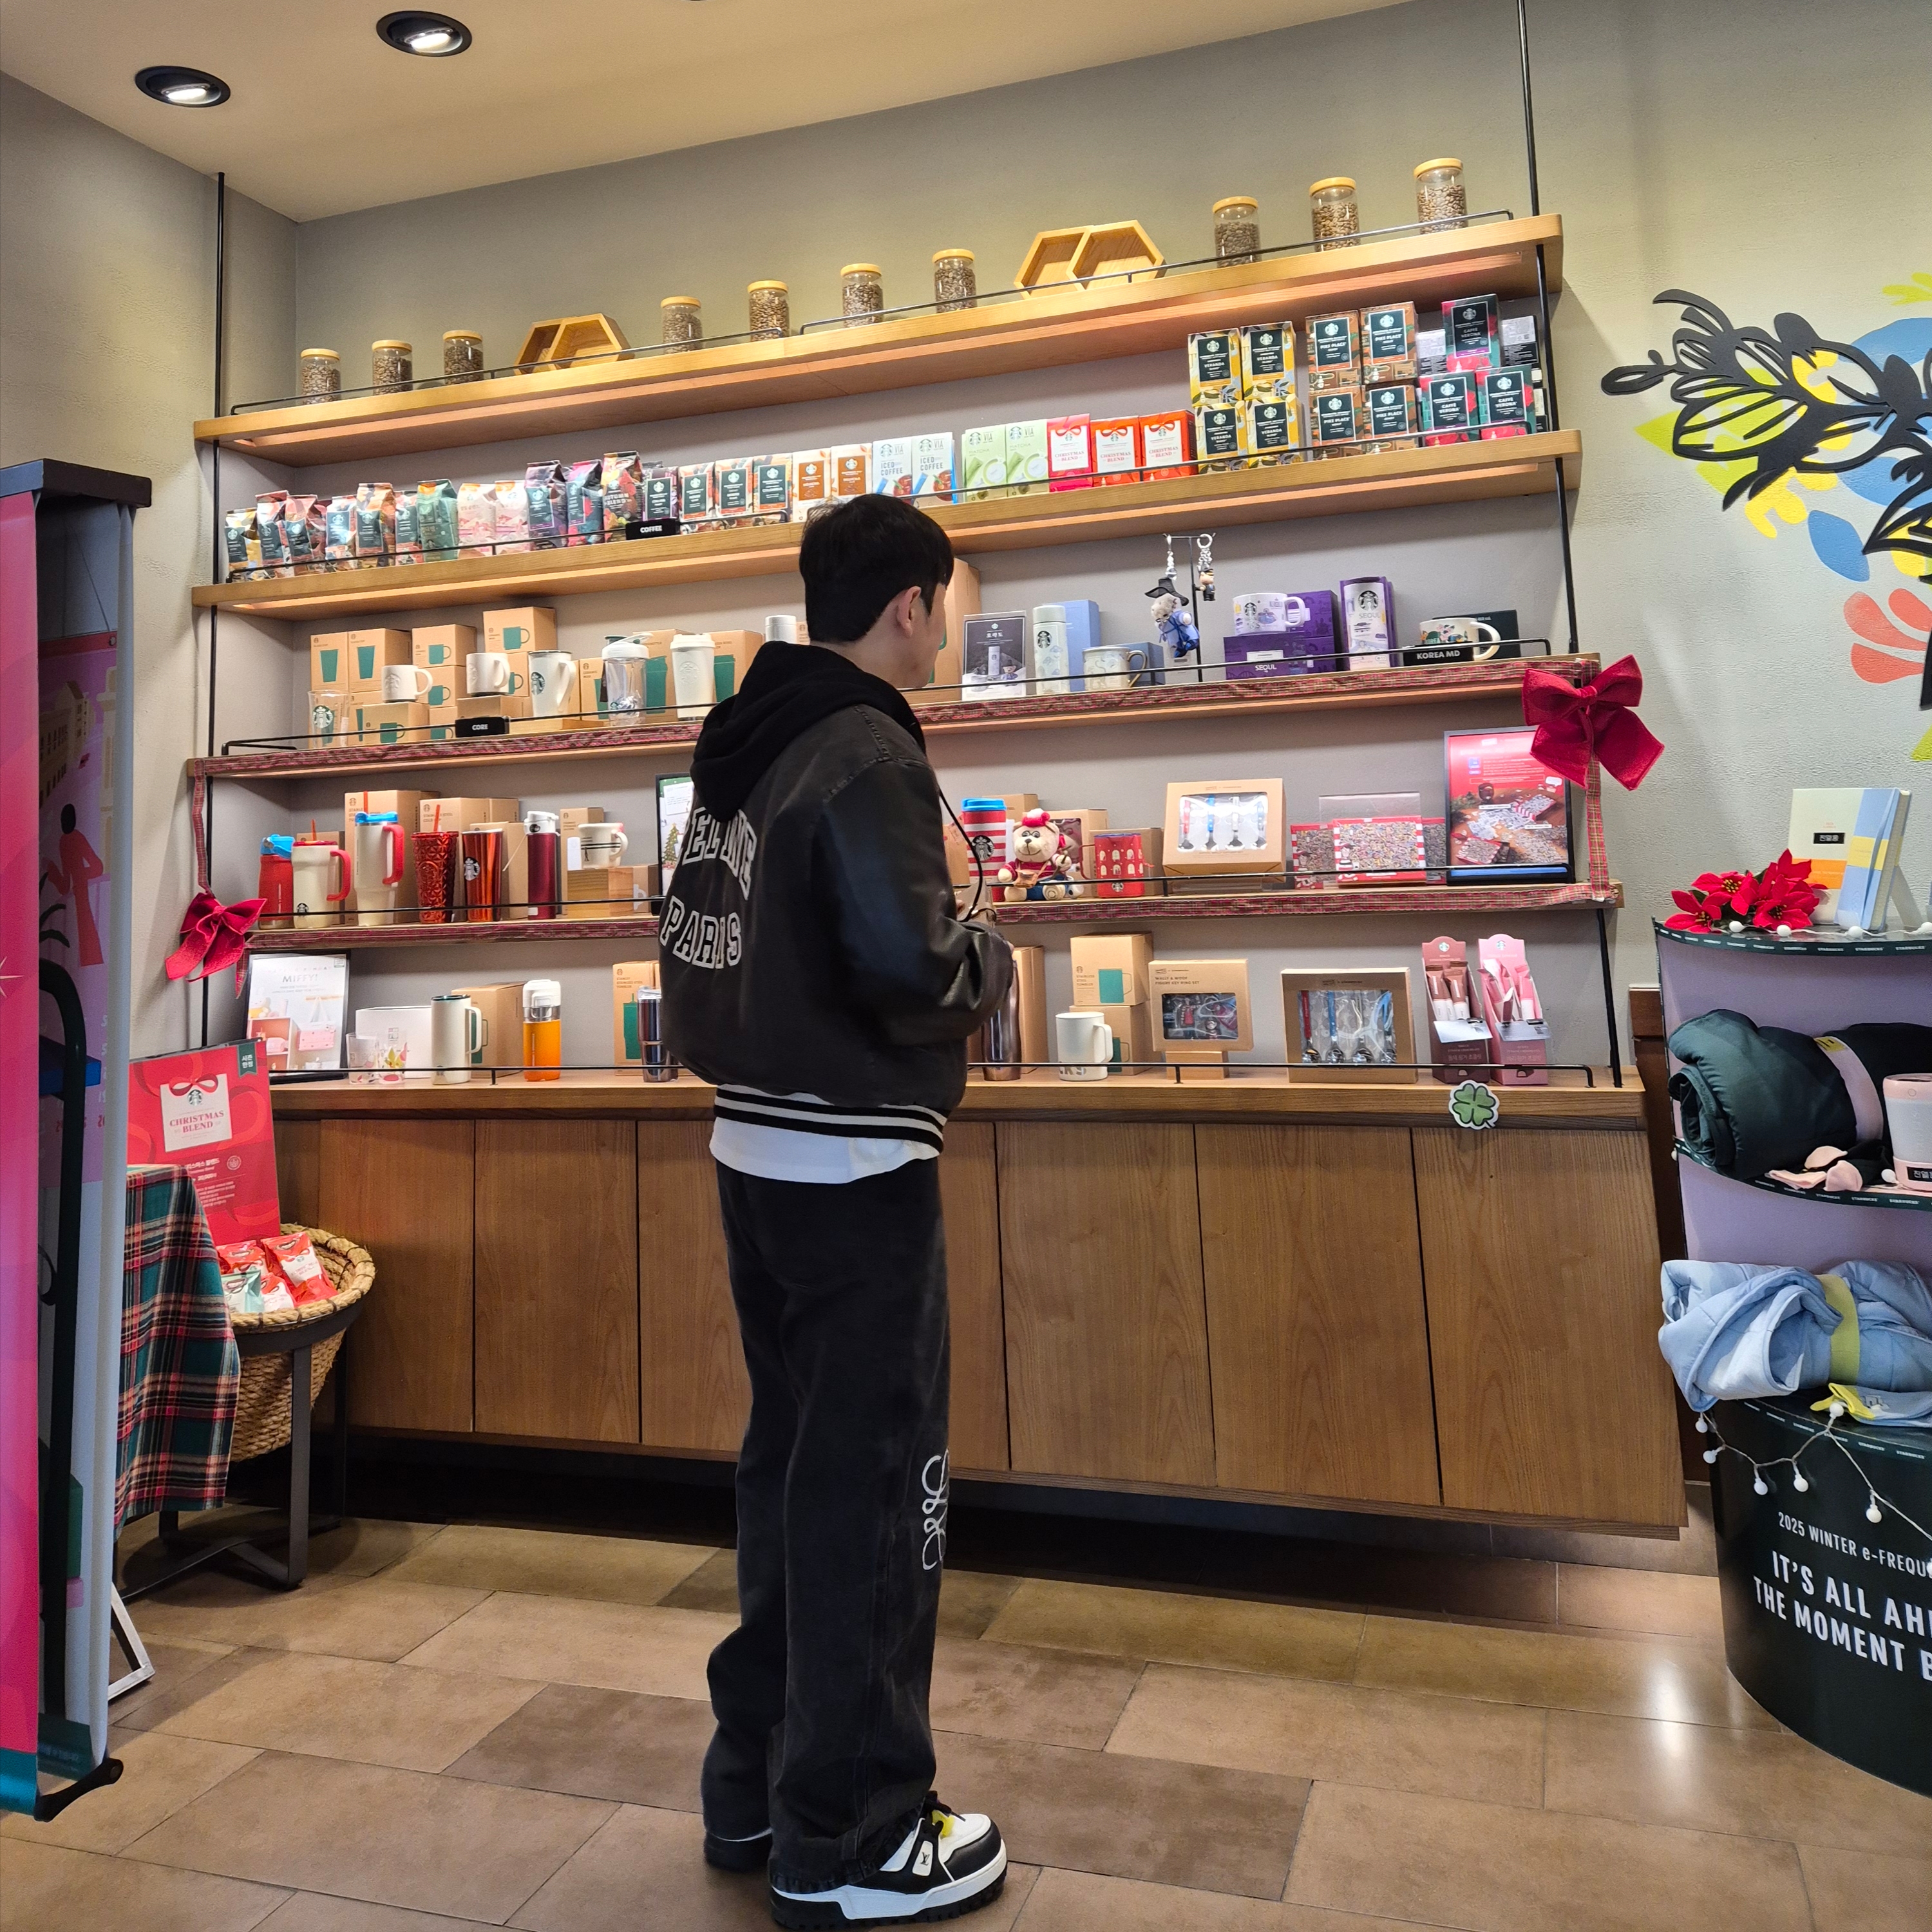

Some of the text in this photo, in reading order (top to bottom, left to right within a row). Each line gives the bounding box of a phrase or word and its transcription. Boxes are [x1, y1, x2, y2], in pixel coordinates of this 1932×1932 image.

[984, 433, 993, 441] VIA
[895, 445, 904, 453] VIA
[1149, 446, 1179, 455] CHRISTMAS
[920, 462, 943, 471] COFFEE
[881, 468, 903, 476] COFFEE
[1417, 651, 1445, 659] KOREA
[659, 895, 742, 969] PARIS
[282, 974, 318, 983] MIFFY!
[170, 1110, 224, 1127] CHRISTMAS
[183, 1121, 213, 1133] BLEND
[1858, 1441, 1885, 1452] STARBUCKS
[1896, 1450, 1926, 1459] STARBUCKS
[1777, 1511, 1932, 1578] 2025 WINTER e-FREQU
[1772, 1550, 1815, 1596] IT'S
[1826, 1577, 1871, 1619] ALL
[1753, 1575, 1787, 1621] THE
[1794, 1600, 1905, 1672] MOMENT
